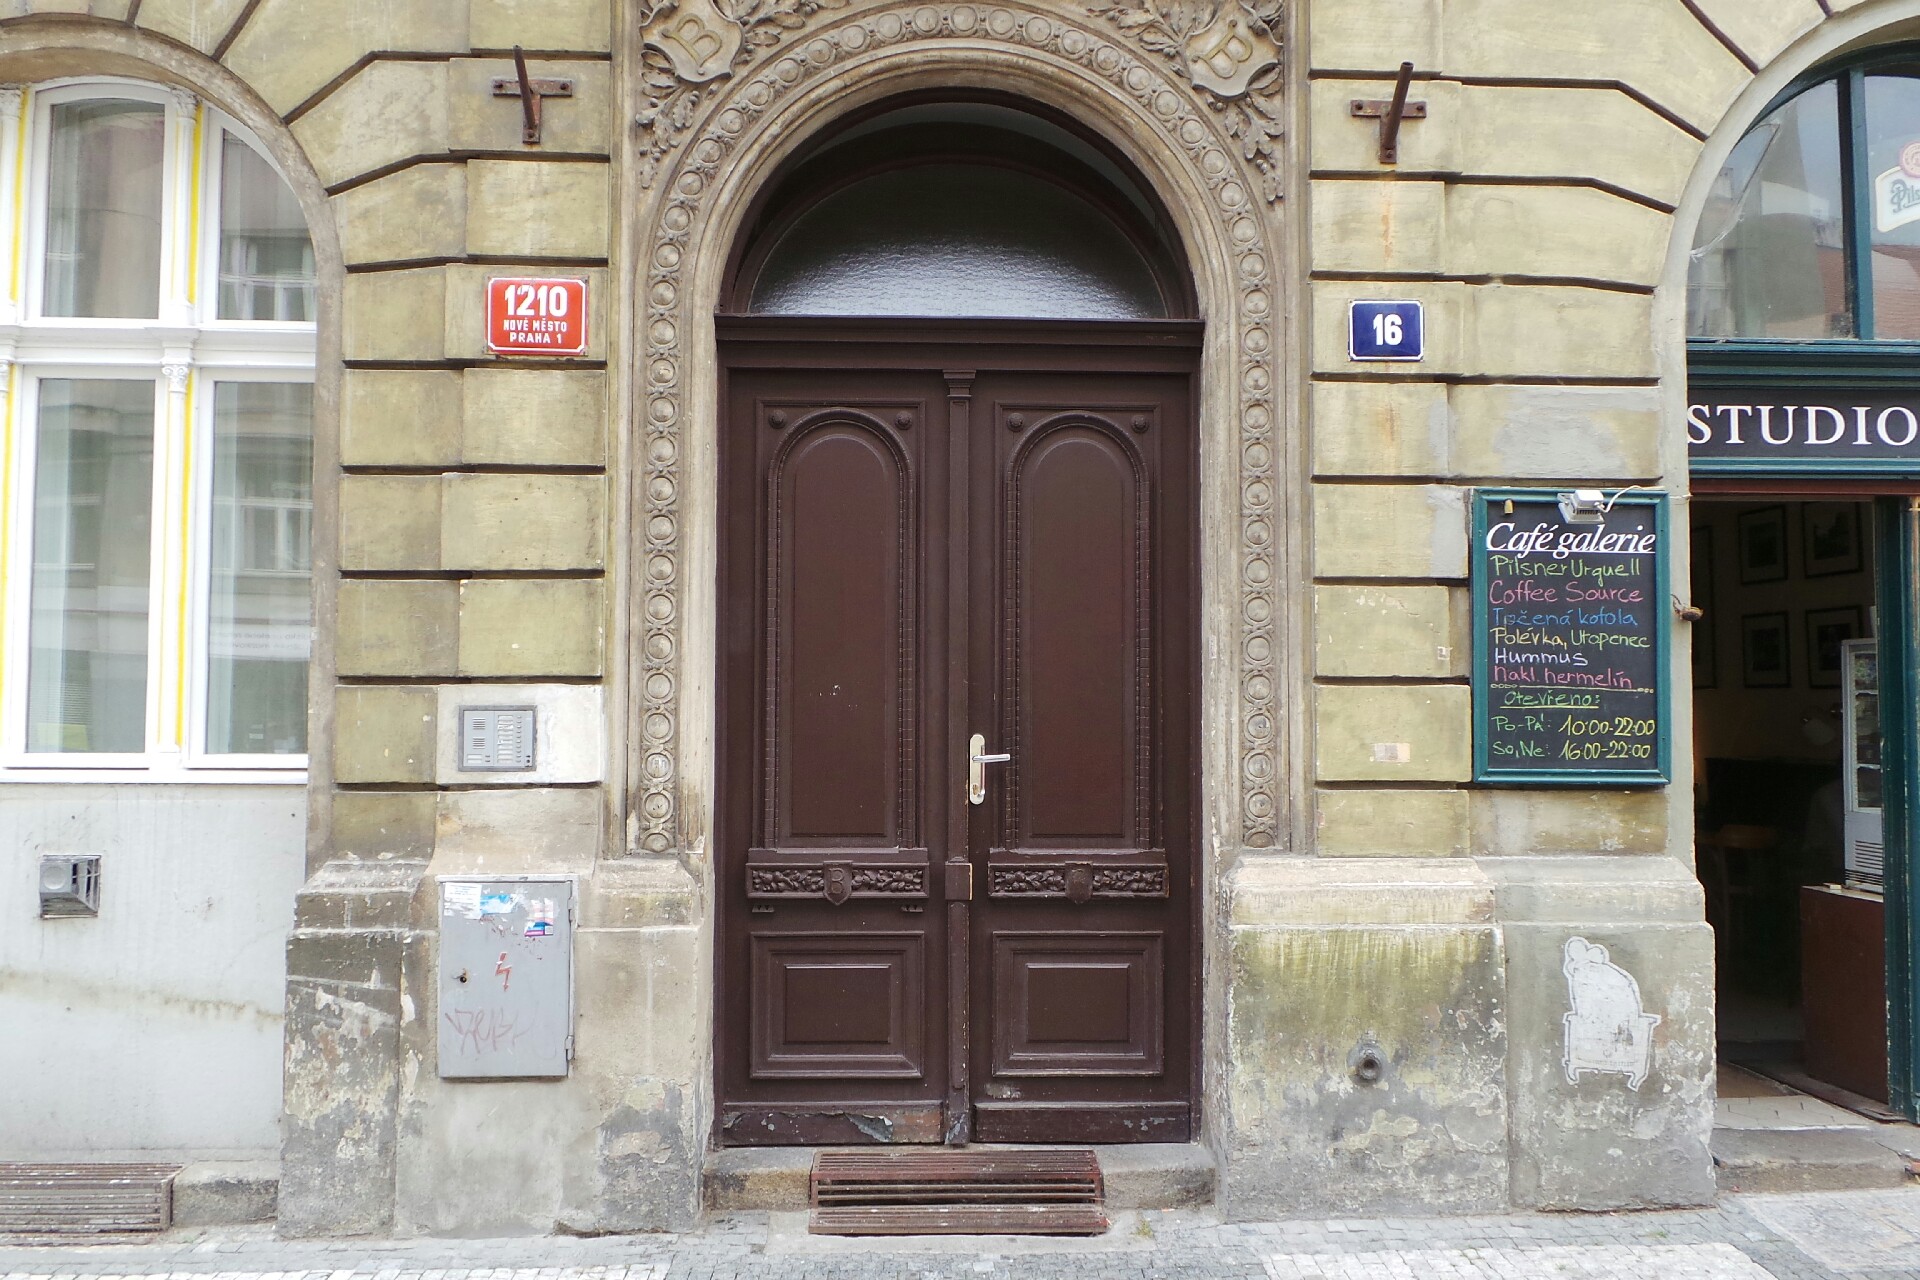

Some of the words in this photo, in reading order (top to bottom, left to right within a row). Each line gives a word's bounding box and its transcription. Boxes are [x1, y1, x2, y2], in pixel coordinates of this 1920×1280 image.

[504, 284, 568, 317] 1210
[503, 317, 529, 331] NOVÉ
[532, 318, 568, 333] MĚSTO
[1373, 313, 1403, 346] 16
[509, 332, 551, 344] PRAHA
[556, 333, 562, 344] 1
[1687, 404, 1919, 446] STUDIO
[1486, 523, 1558, 559] Café
[1553, 524, 1657, 559] galerie
[1490, 555, 1567, 576] Pilsner
[1571, 558, 1640, 586] Urquell
[1490, 580, 1558, 604] Coffee
[1566, 581, 1643, 602] Source
[1490, 628, 1567, 650] Polévka,
[1571, 630, 1650, 650] Utopenec
[1495, 648, 1588, 666] Hummus
[1545, 668, 1633, 689] hermelín
